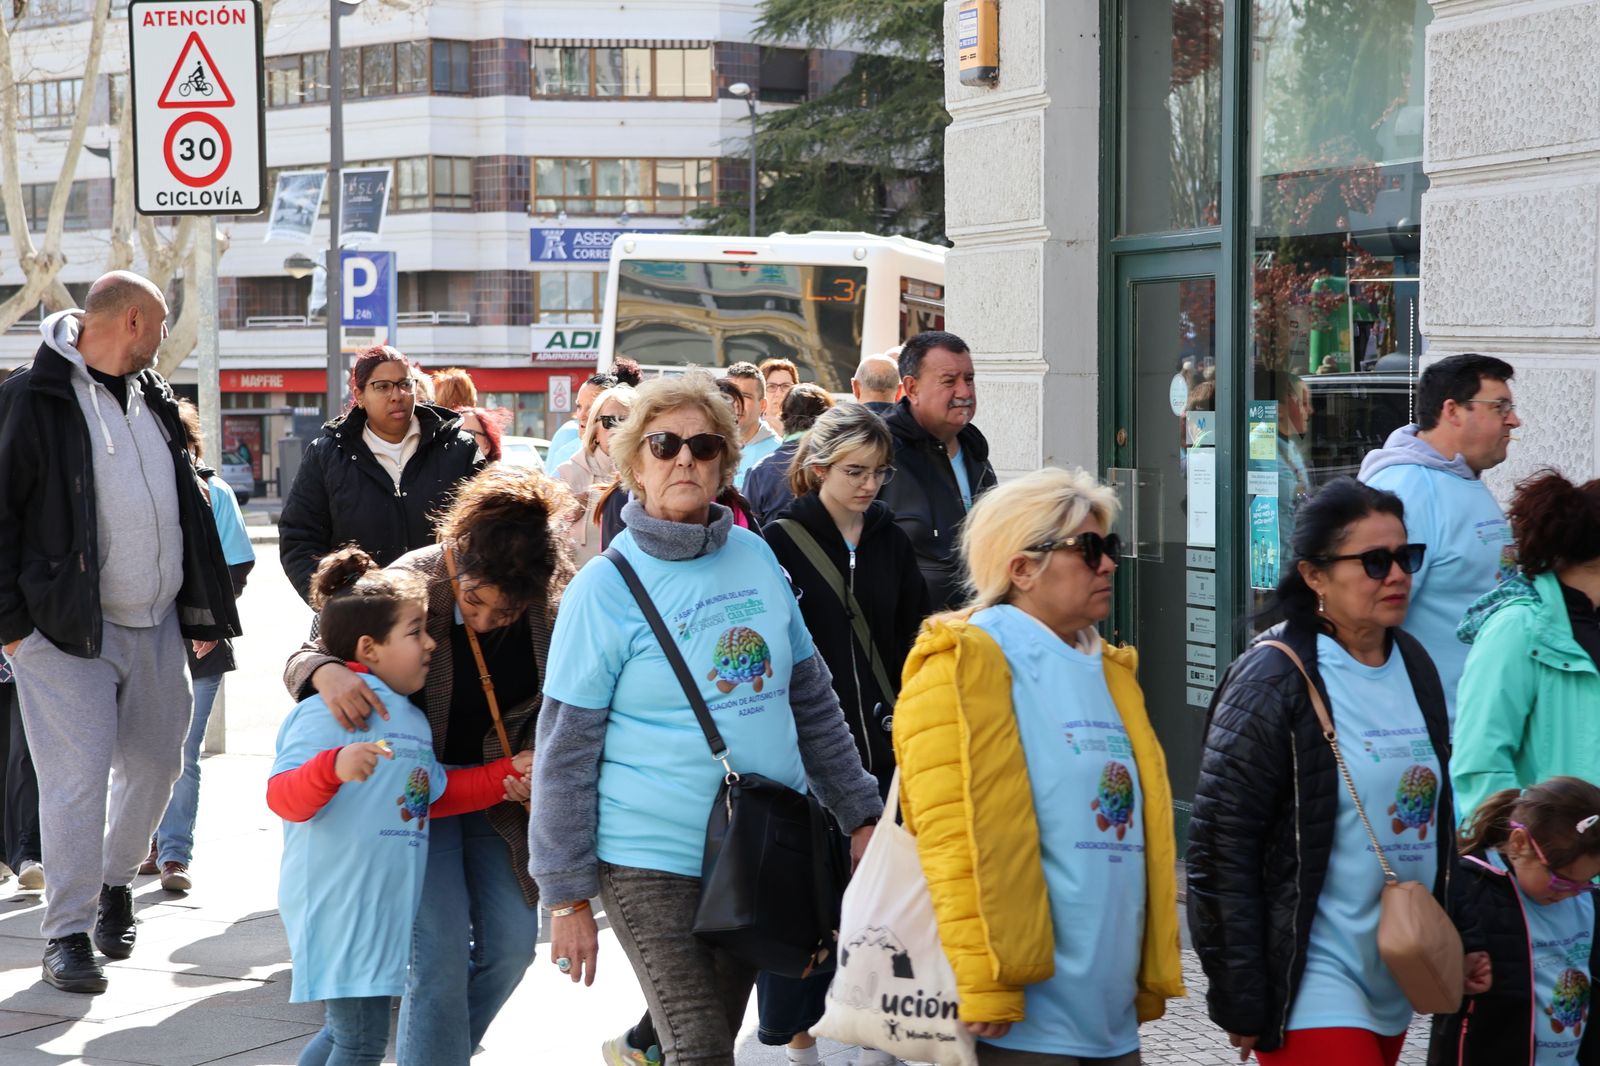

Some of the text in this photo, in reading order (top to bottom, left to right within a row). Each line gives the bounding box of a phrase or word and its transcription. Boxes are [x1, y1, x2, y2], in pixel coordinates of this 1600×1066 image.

[143, 6, 246, 27] ATENCIÓN
[179, 137, 216, 161] 30
[156, 187, 243, 206] CICLOVÍA
[573, 248, 610, 260] CORRE
[343, 257, 378, 320] P
[355, 309, 372, 320] 24h
[536, 353, 598, 361] ADMINISTRACIO
[241, 374, 284, 388] MAPFRE
[709, 699, 739, 712] CIACIÓN
